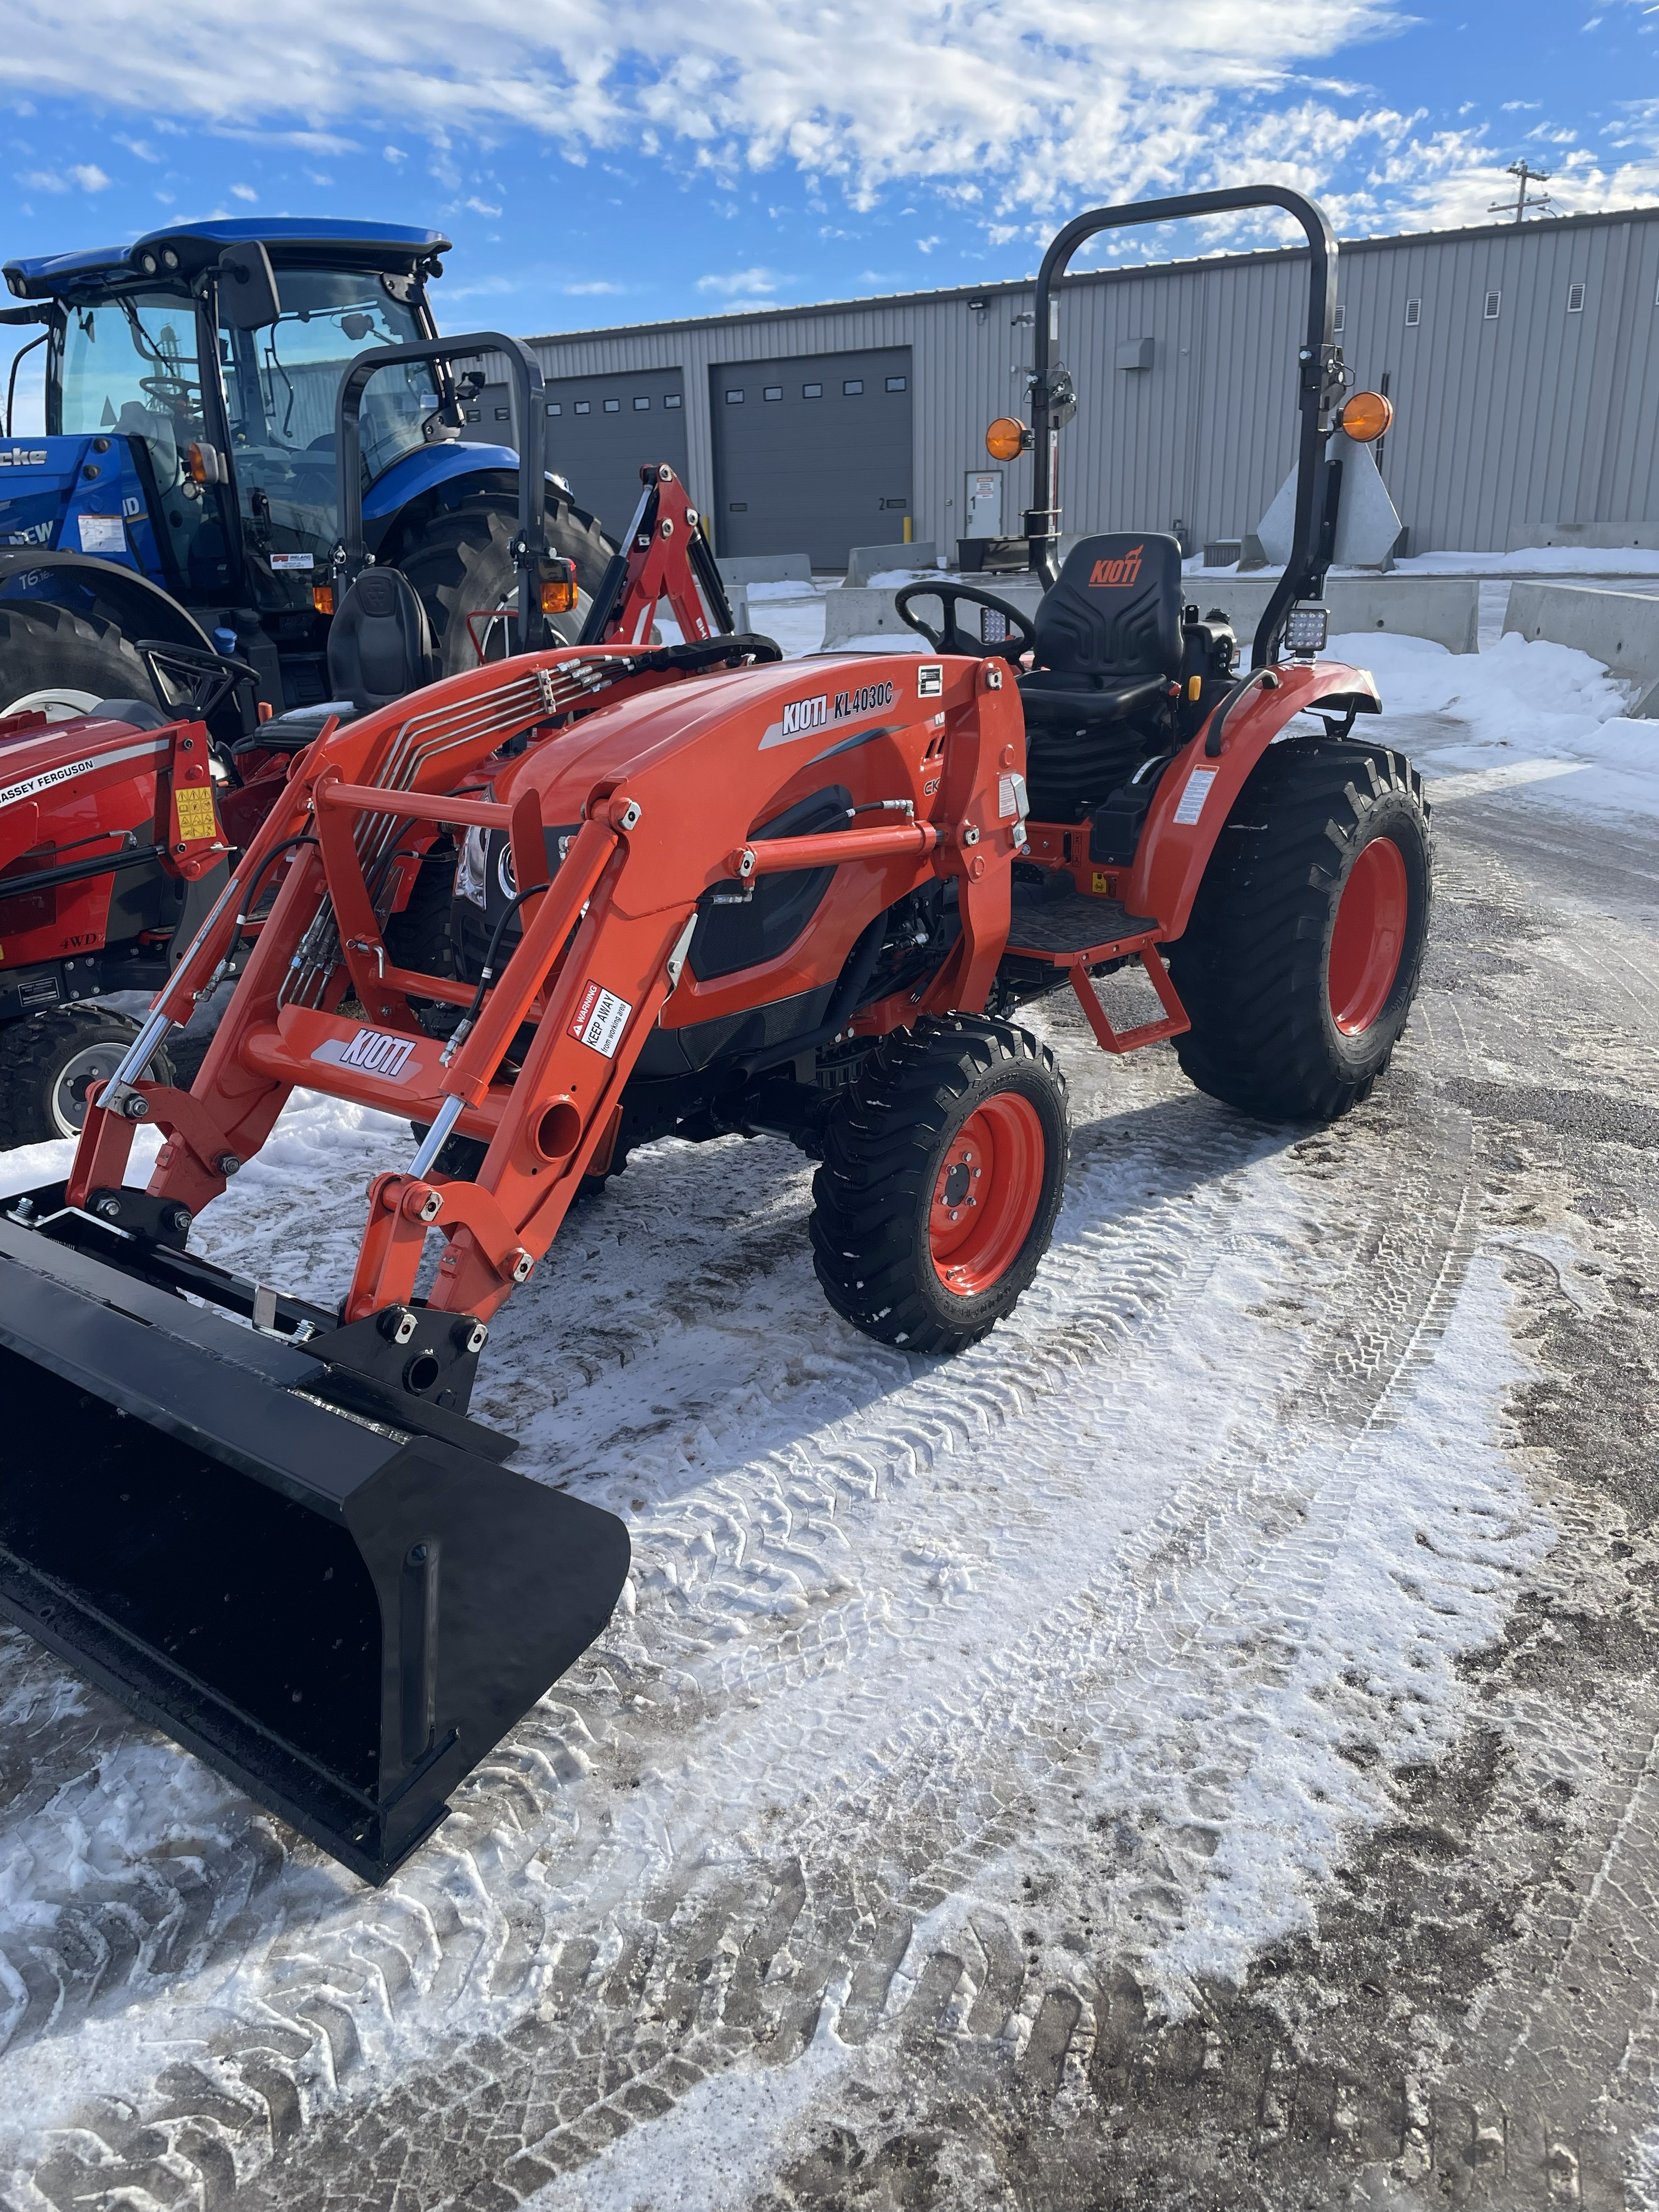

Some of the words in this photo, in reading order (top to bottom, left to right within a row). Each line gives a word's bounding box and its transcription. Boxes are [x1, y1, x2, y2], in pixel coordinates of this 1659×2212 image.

[879, 497, 885, 511] 2
[970, 496, 976, 510] 1
[1089, 559, 1142, 583] KIOTI
[782, 694, 827, 736] KIOTI
[833, 680, 893, 721] KL4030C
[0, 781, 34, 804] ASSEY
[37, 760, 94, 787] FERGUSON
[60, 933, 97, 949] 4WD
[576, 985, 597, 1023] WARNING
[586, 1022, 603, 1047] KEEP
[597, 994, 614, 1023] AWAY
[601, 1039, 611, 1053] from
[608, 1015, 622, 1040] working
[618, 1003, 627, 1017] area
[339, 1028, 417, 1076] KIOTI
